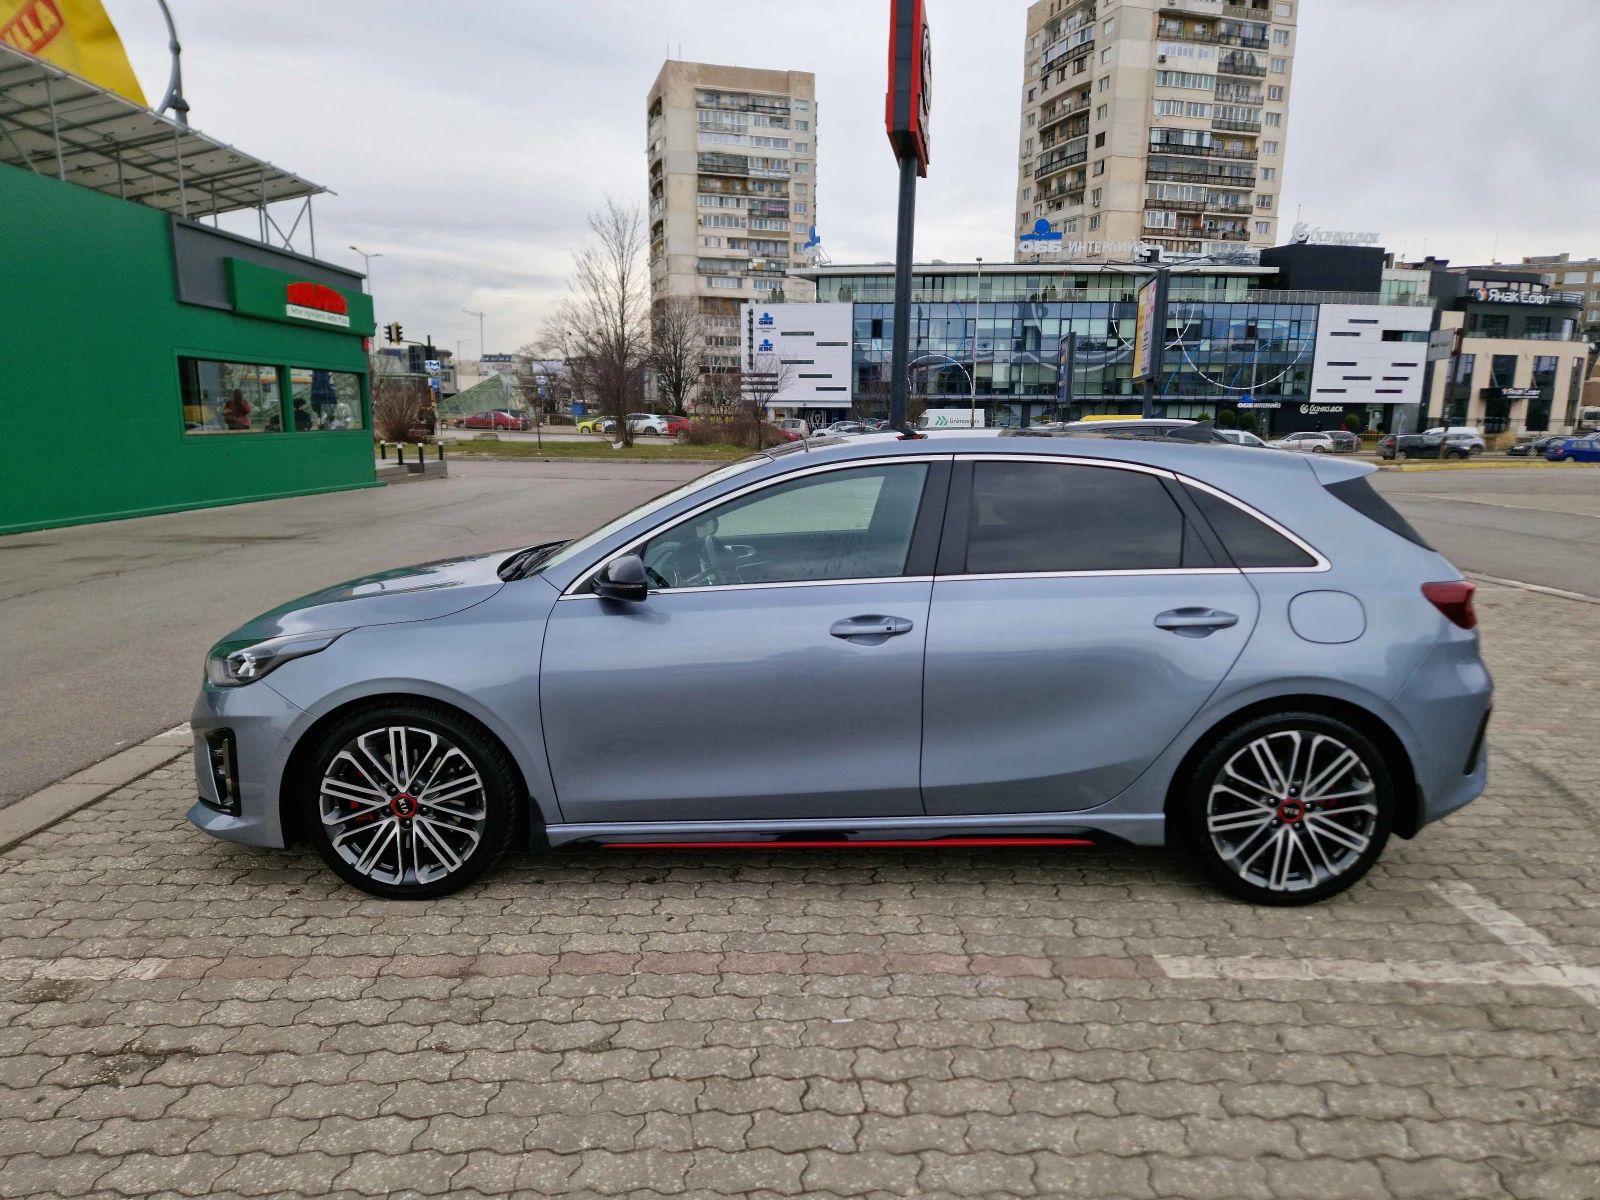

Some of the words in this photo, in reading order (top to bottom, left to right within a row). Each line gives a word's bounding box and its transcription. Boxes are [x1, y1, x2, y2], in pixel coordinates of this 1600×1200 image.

[1019, 240, 1062, 253] ОББ
[398, 798, 408, 814] KIA
[1284, 806, 1300, 814] KIA
